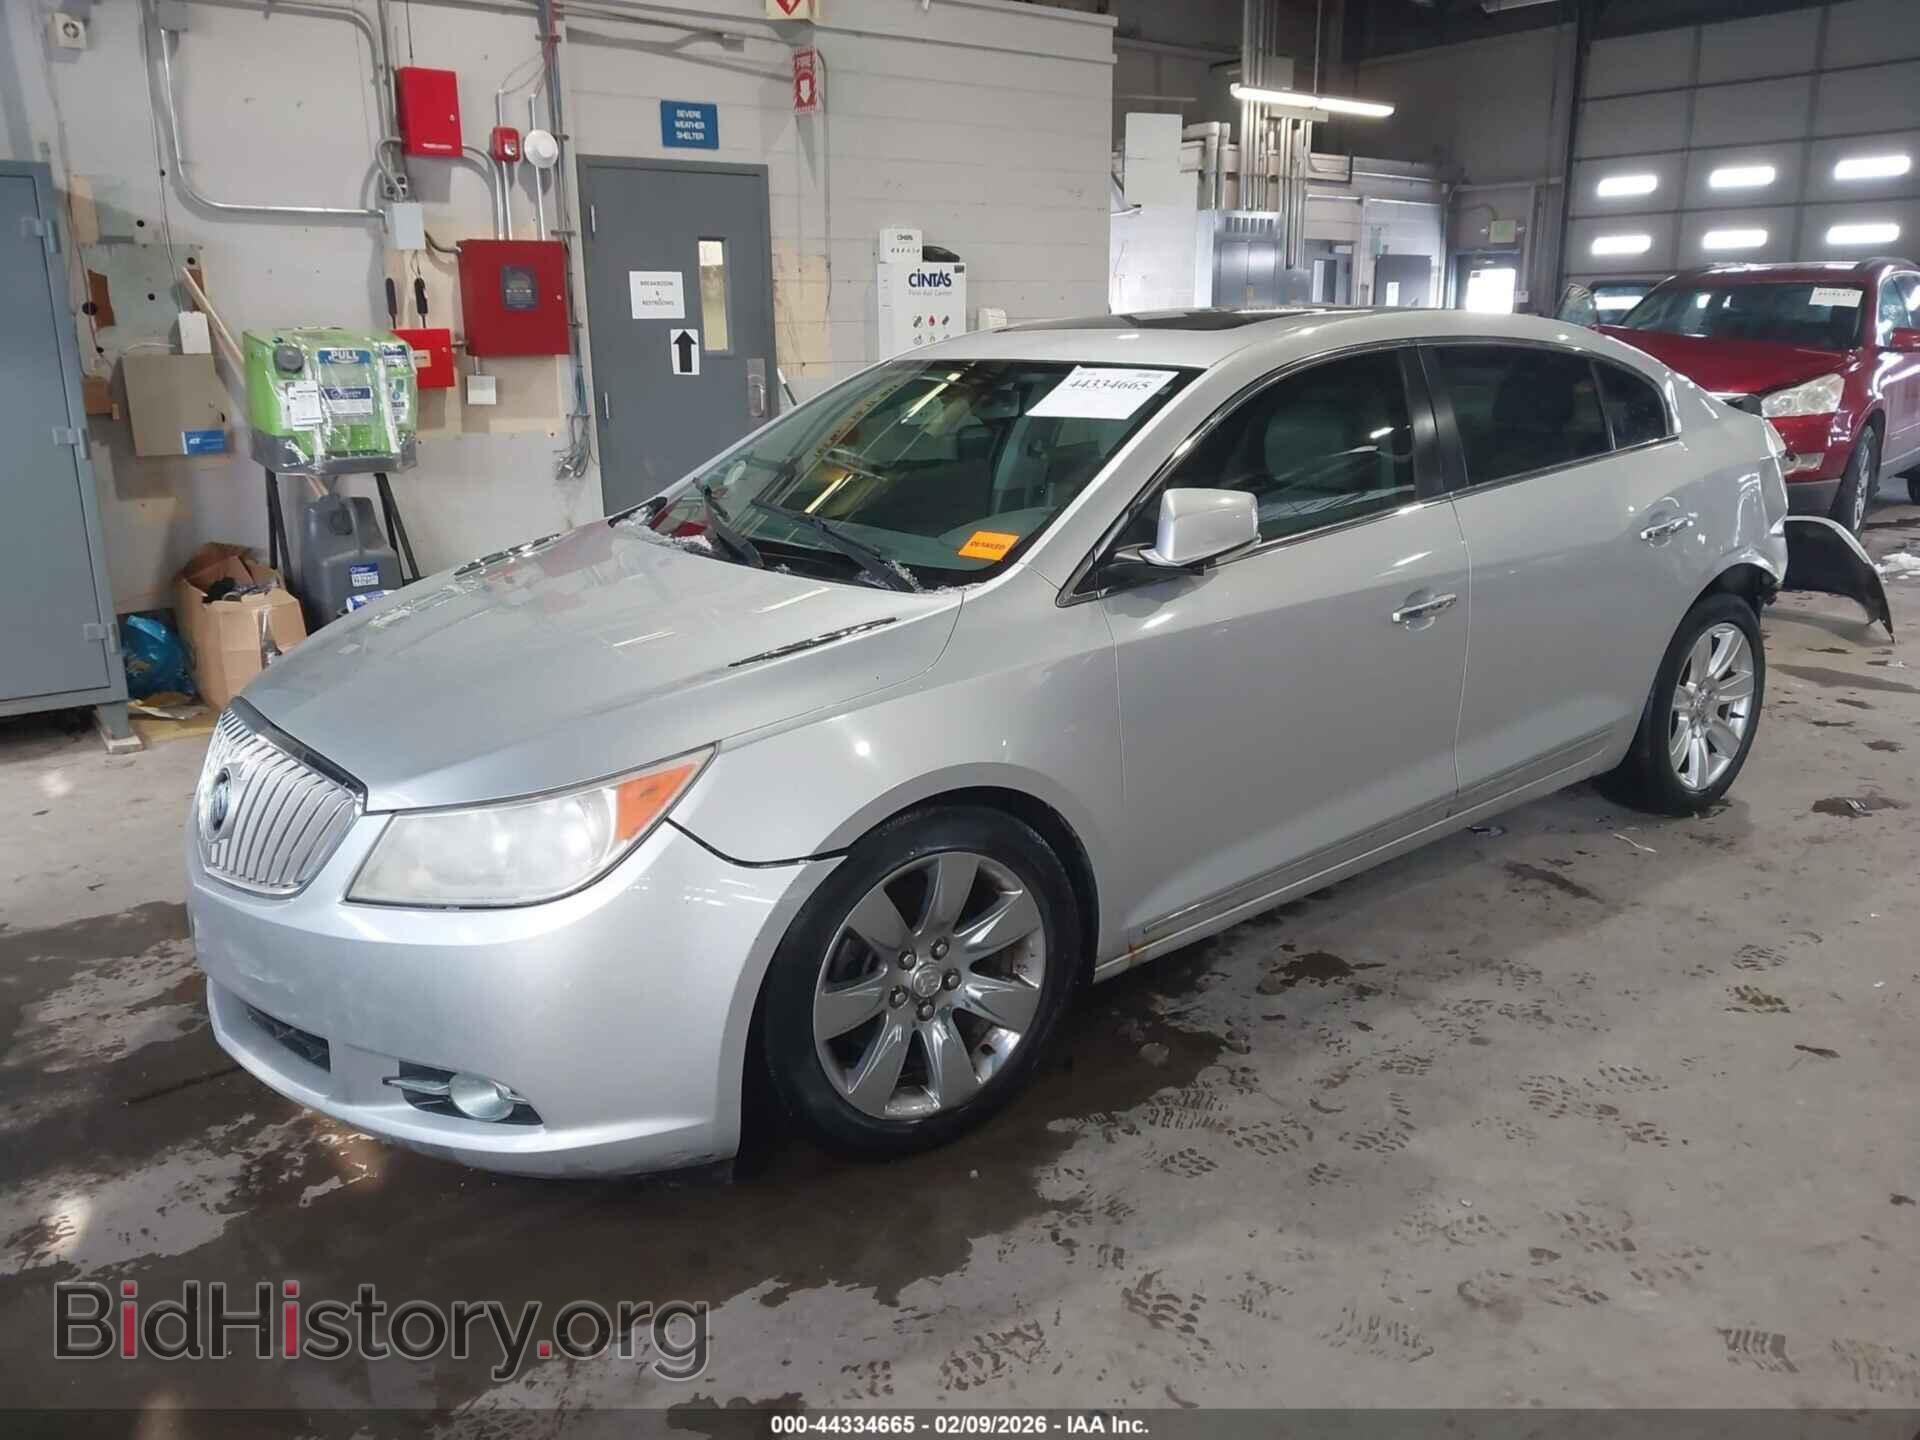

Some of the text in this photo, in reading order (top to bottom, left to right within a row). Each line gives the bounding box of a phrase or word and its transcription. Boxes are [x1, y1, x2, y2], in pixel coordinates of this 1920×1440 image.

[676, 109, 702, 119] SEVERE
[674, 120, 705, 130] WEATHER
[675, 131, 705, 141] SHELTER
[908, 267, 952, 288] CINTAS
[328, 349, 361, 361] PULL
[1068, 378, 1153, 392] 44334665
